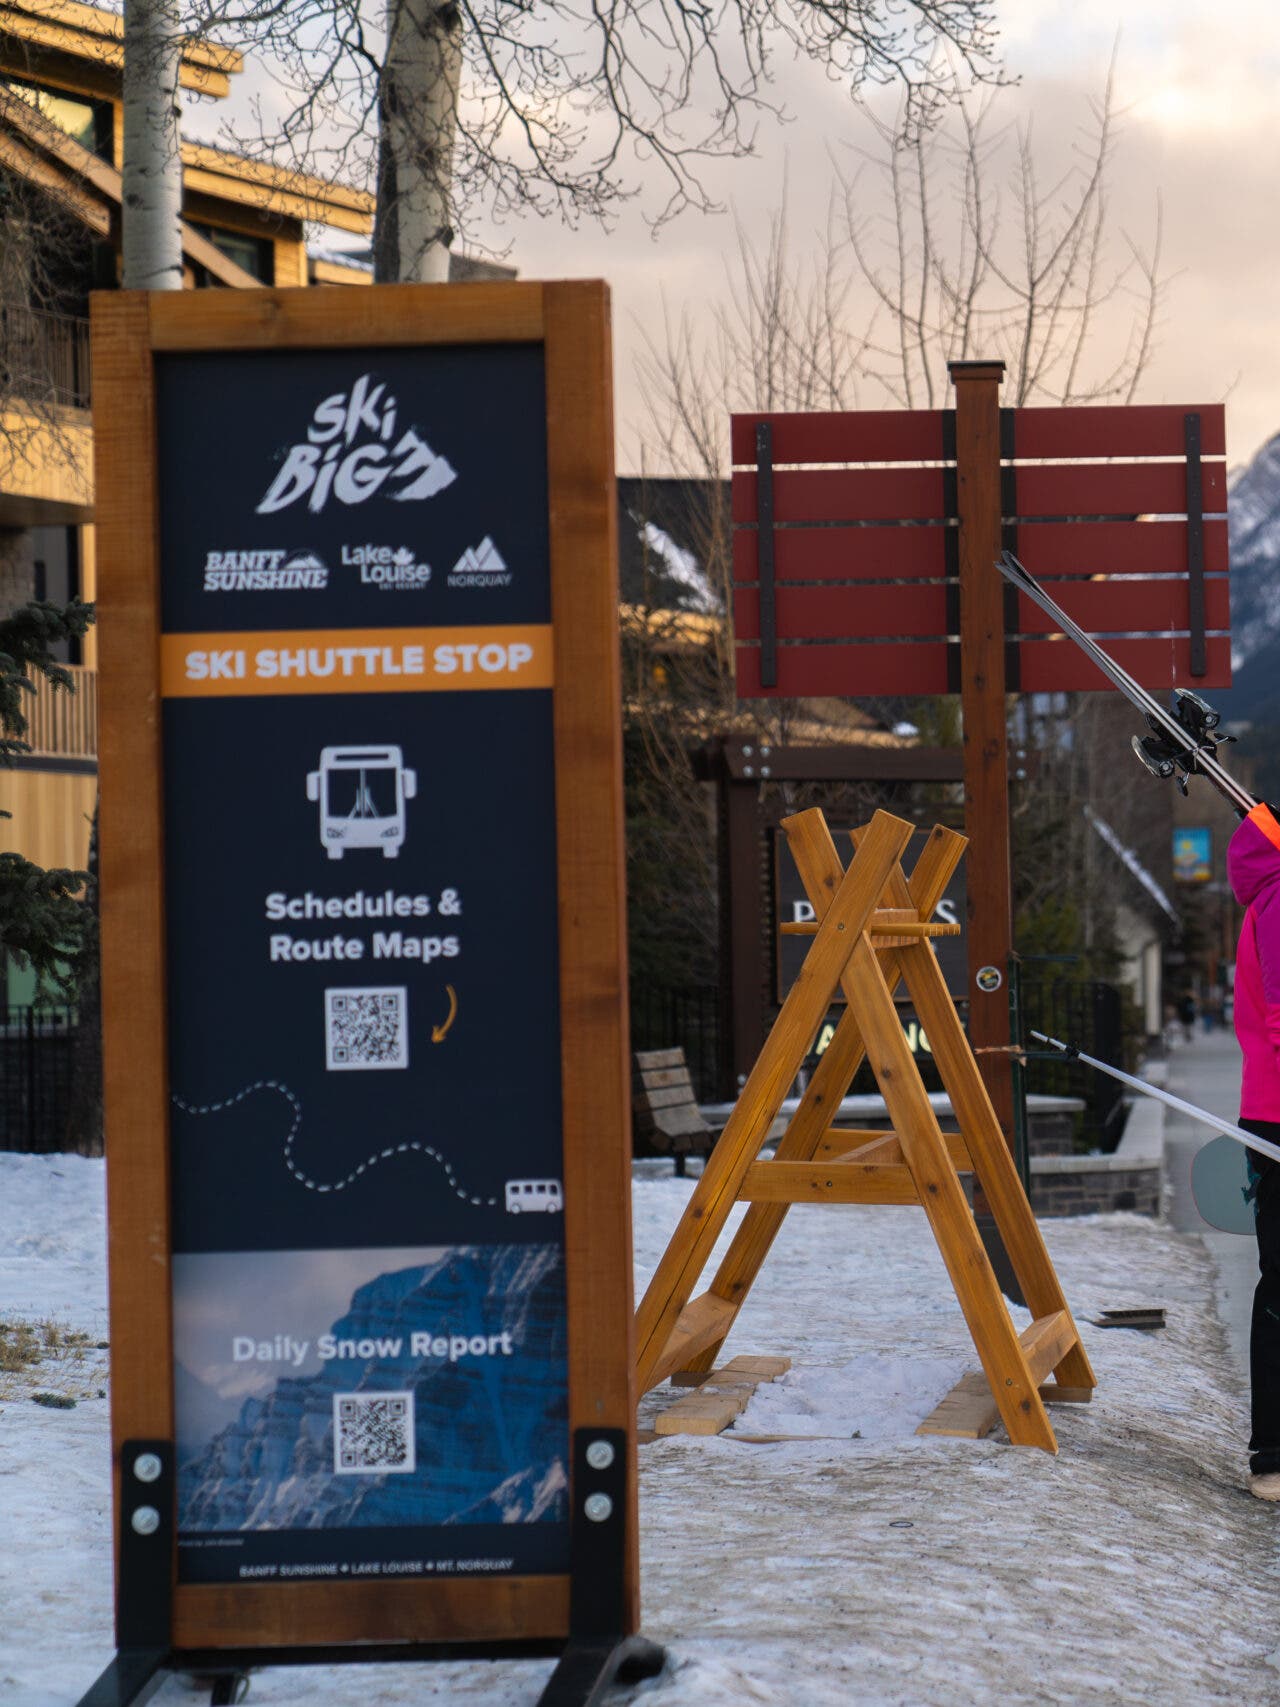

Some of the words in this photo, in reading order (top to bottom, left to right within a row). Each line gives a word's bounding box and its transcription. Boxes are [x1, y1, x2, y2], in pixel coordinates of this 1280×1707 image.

[205, 551, 286, 571] BANFF
[341, 544, 392, 566] Lake
[203, 569, 328, 591] SUNSHINE
[361, 563, 432, 583] Louise
[447, 574, 512, 586] NORQUAY
[185, 651, 245, 679] SKI
[255, 646, 424, 677] SHUTTLE
[433, 643, 533, 673] STOP
[265, 891, 430, 919] Schedules
[438, 888, 461, 915] &
[270, 934, 364, 962] Route
[373, 931, 460, 964] Maps
[233, 1336, 308, 1366] Daily
[317, 1334, 402, 1359] Snow
[410, 1331, 512, 1361] Report
[239, 1564, 277, 1577] BANFF
[279, 1562, 338, 1576] SUNSHINE
[351, 1561, 380, 1574] LAKE
[382, 1560, 422, 1573] LOUISE
[456, 1558, 513, 1571] NORQUAY
